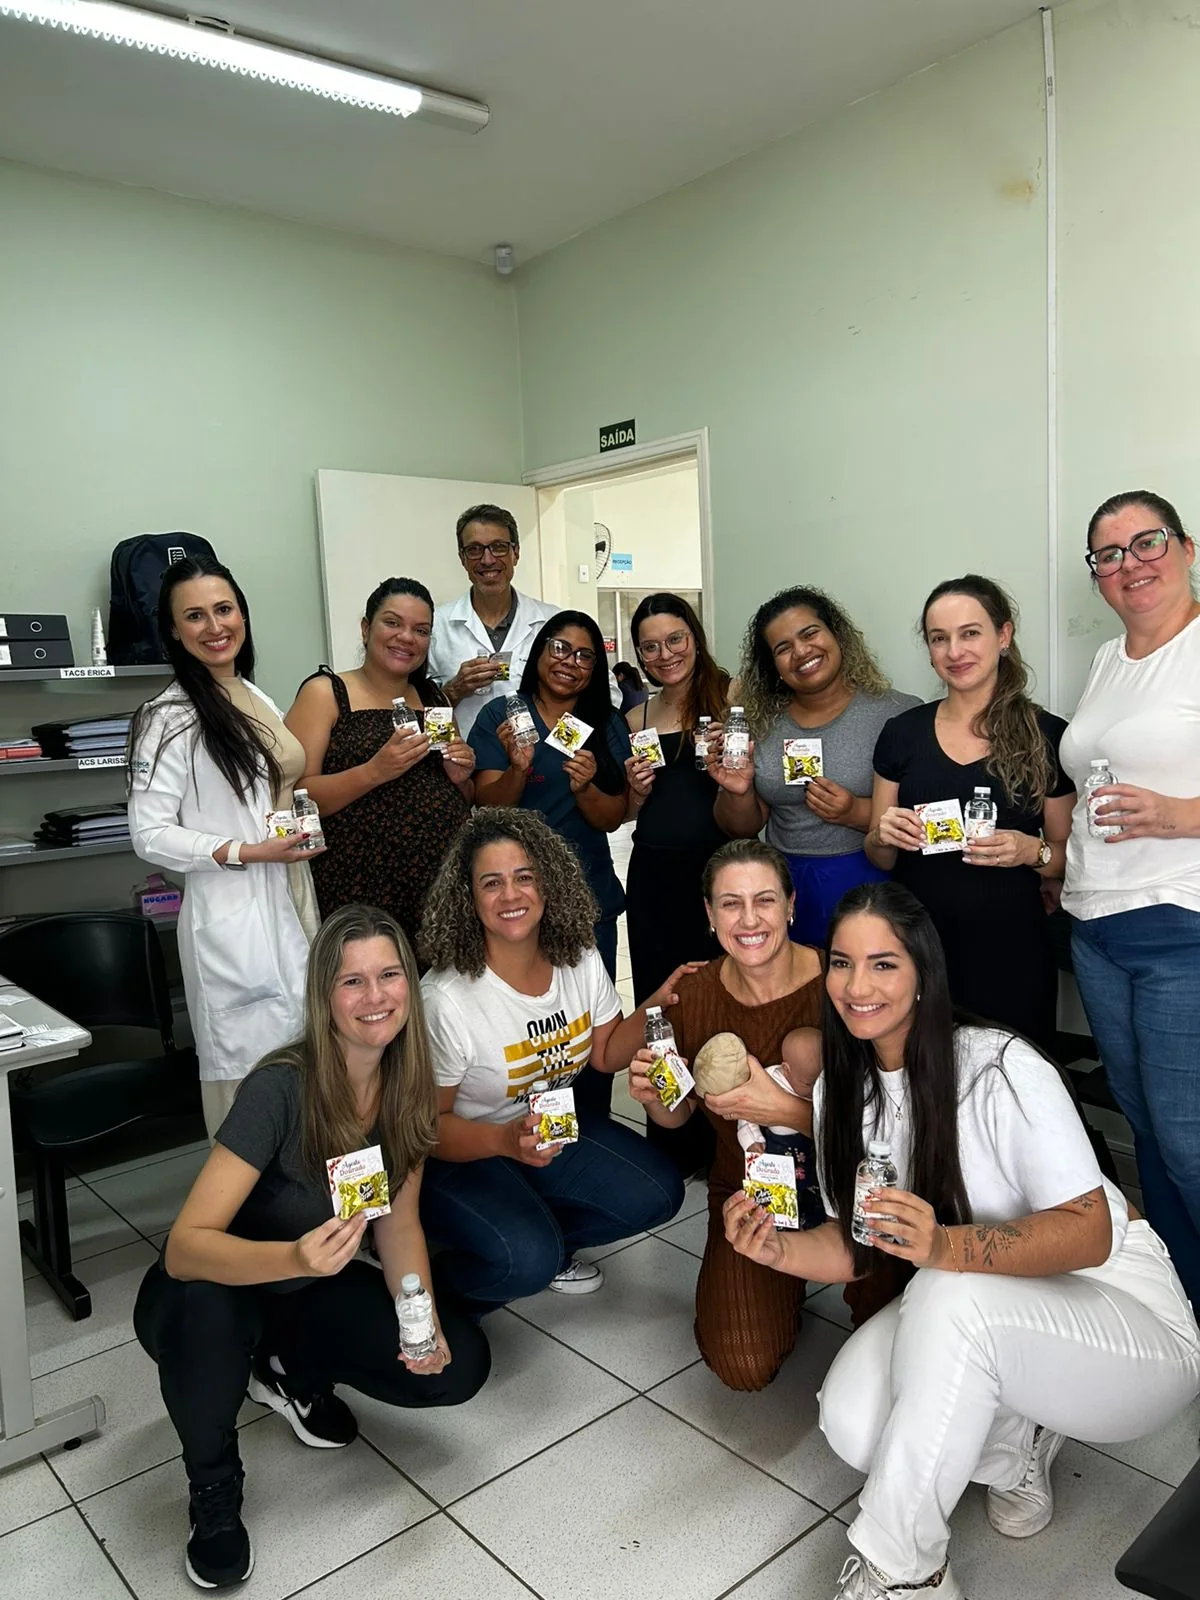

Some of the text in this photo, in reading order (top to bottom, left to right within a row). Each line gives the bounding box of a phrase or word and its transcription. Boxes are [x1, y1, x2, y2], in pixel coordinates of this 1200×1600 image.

[600, 428, 635, 448] SAÍDA
[526, 1010, 570, 1047] OWN
[537, 1041, 574, 1074] THE
[868, 1560, 888, 1583] adidas
